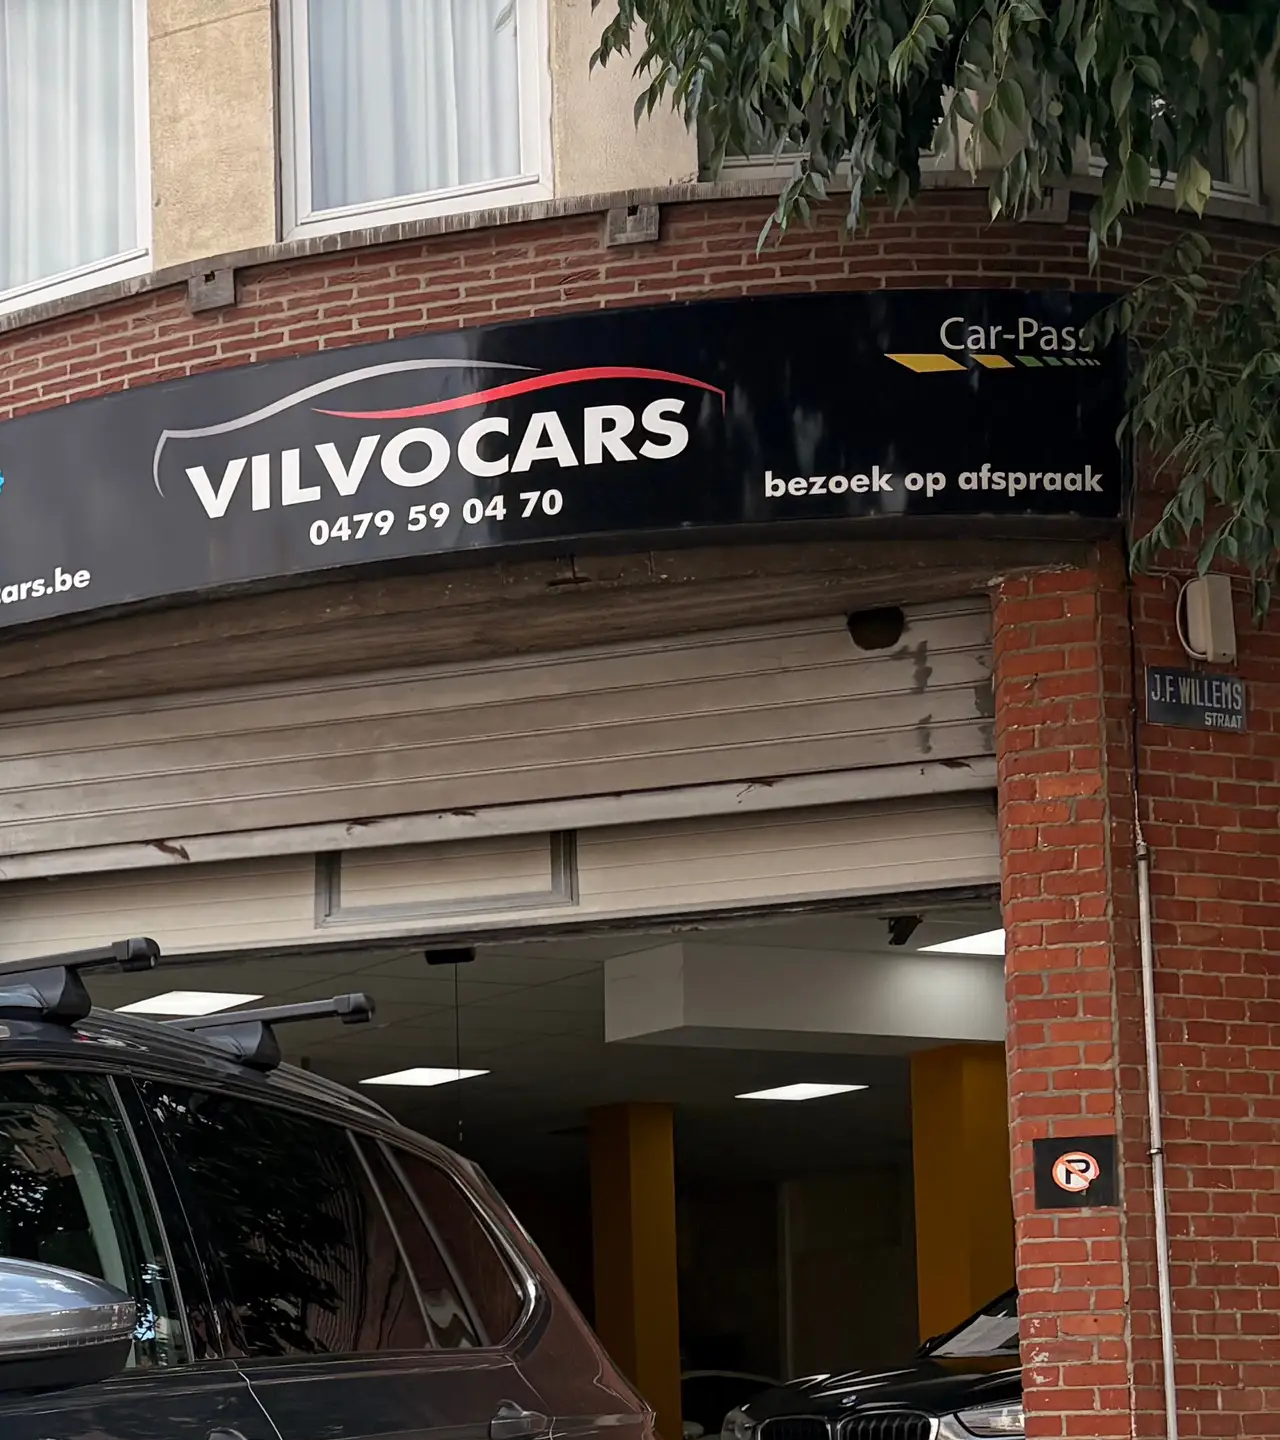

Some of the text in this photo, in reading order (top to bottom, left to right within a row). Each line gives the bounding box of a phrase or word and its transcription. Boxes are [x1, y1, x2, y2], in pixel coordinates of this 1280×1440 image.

[184, 398, 690, 519] VILVOCARS
[765, 463, 1104, 498] bezoek op afspraak
[309, 489, 564, 546] 0479 59 04 70
[1178, 676, 1242, 710] WILLEMS
[1204, 711, 1243, 729] STRAAT
